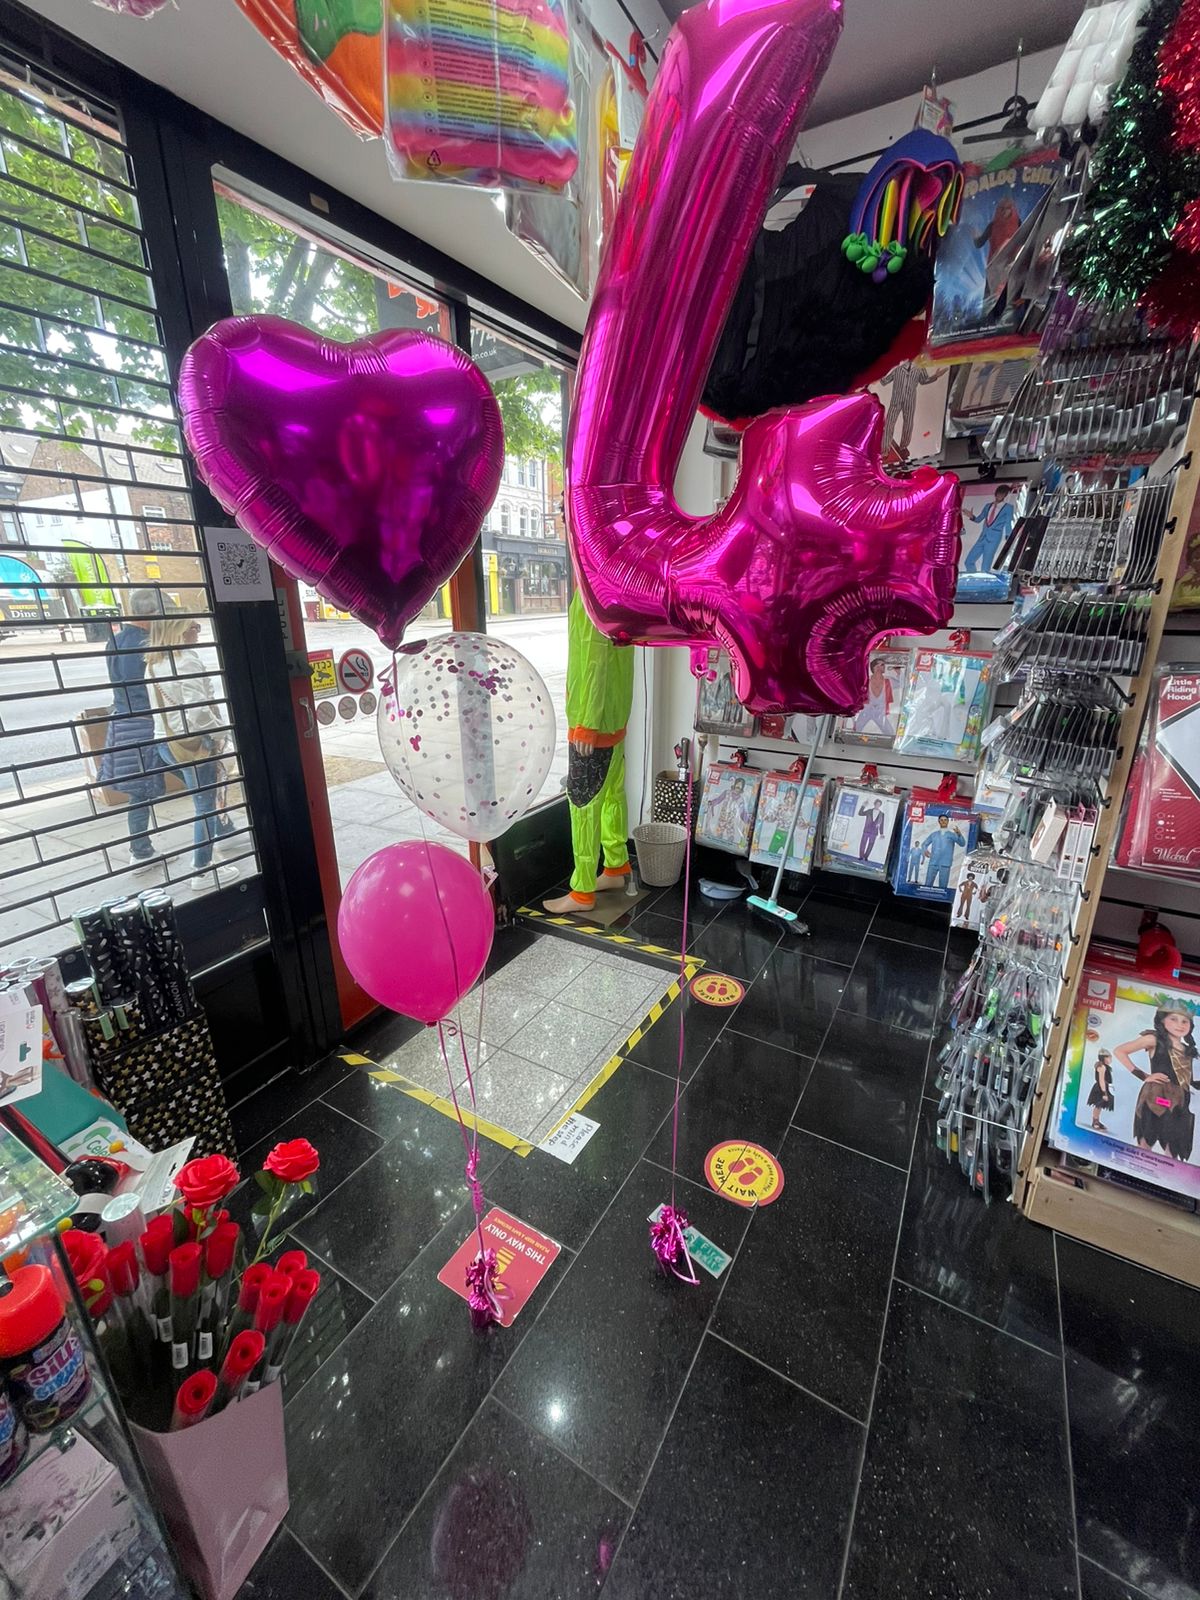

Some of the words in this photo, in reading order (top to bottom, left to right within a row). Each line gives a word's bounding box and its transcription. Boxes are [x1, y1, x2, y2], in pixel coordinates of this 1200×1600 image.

[11, 610, 38, 619] Dine
[1167, 686, 1197, 694] Riding
[1167, 693, 1192, 701] Hood
[170, 981, 185, 1018] CANNON
[1082, 997, 1112, 1011] smiffys
[562, 1117, 576, 1130] the
[549, 1130, 564, 1146] step
[561, 1125, 579, 1146] mind
[715, 1157, 726, 1185] HERE
[727, 1184, 758, 1197] WAIT
[485, 1223, 508, 1240] ONLY
[506, 1237, 526, 1253] WAY
[525, 1247, 546, 1265] THIS
